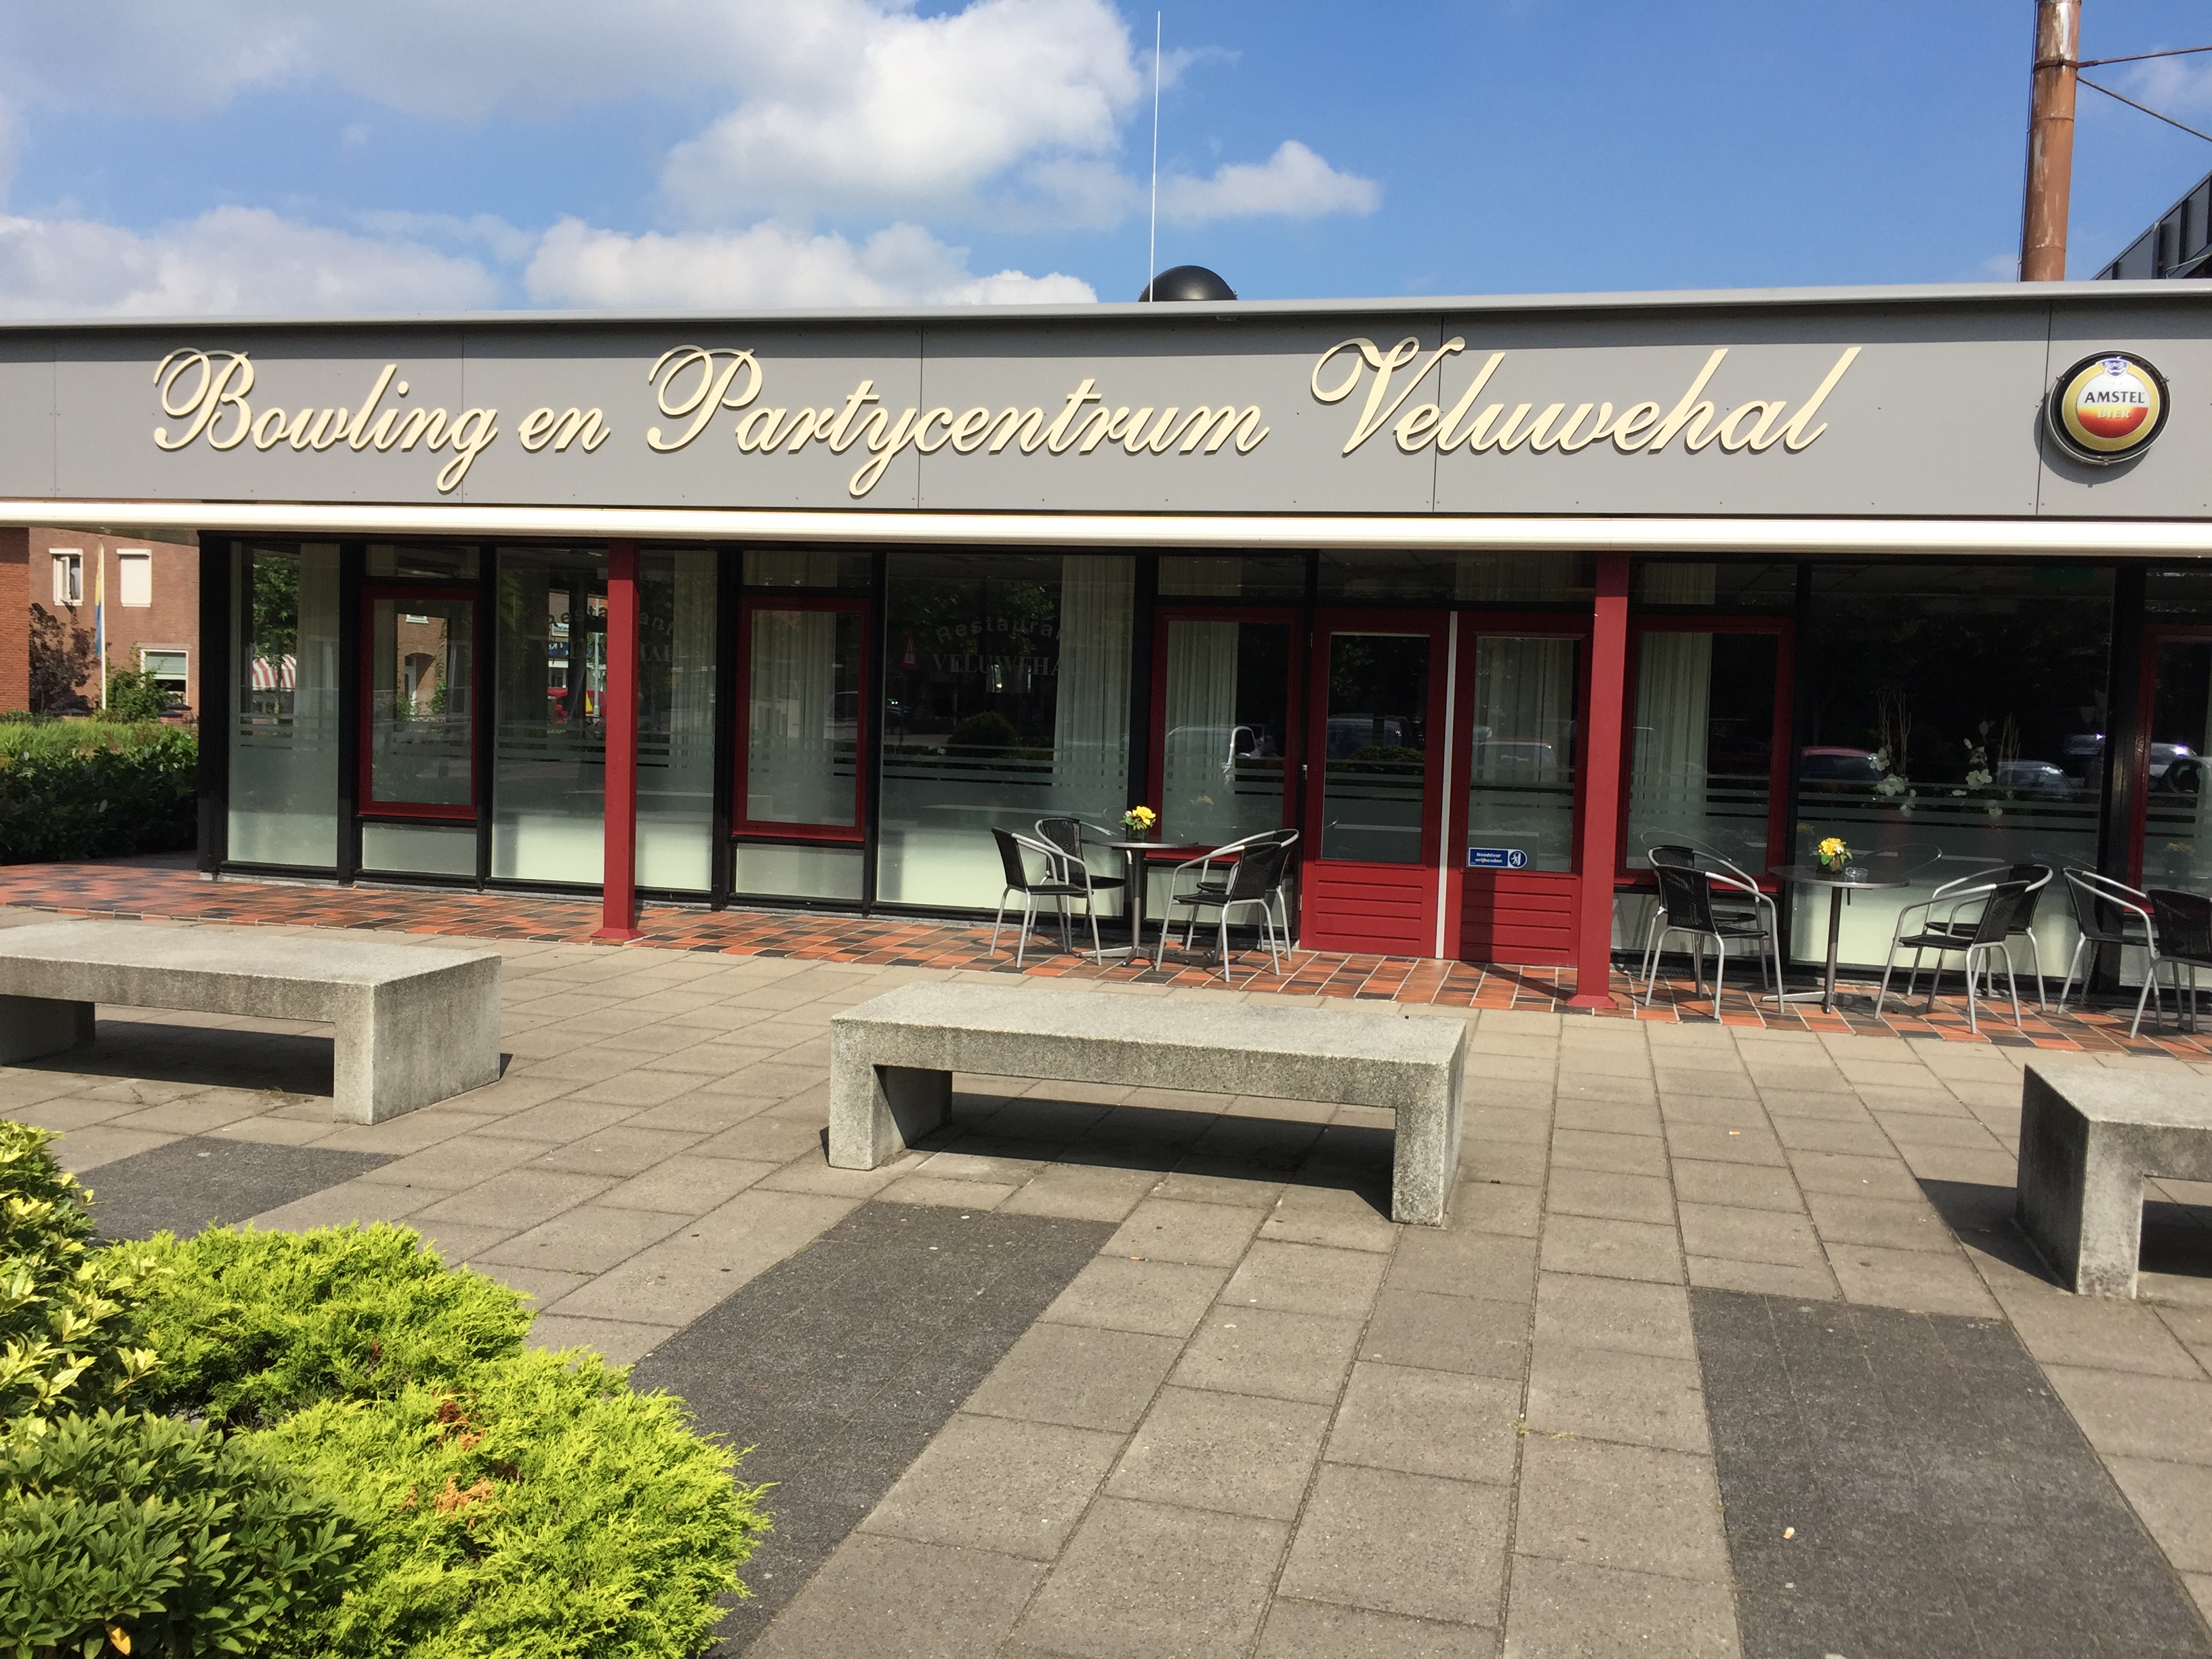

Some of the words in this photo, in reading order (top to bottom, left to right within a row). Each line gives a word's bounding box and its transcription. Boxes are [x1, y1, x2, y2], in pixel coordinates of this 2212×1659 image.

[2084, 391, 2145, 404] AMSTEL
[153, 347, 498, 492] Bowling
[518, 407, 611, 451] en
[647, 344, 1271, 497] Partycentrum
[1311, 336, 1862, 455] Veluwehal
[2098, 409, 2131, 419] BIER
